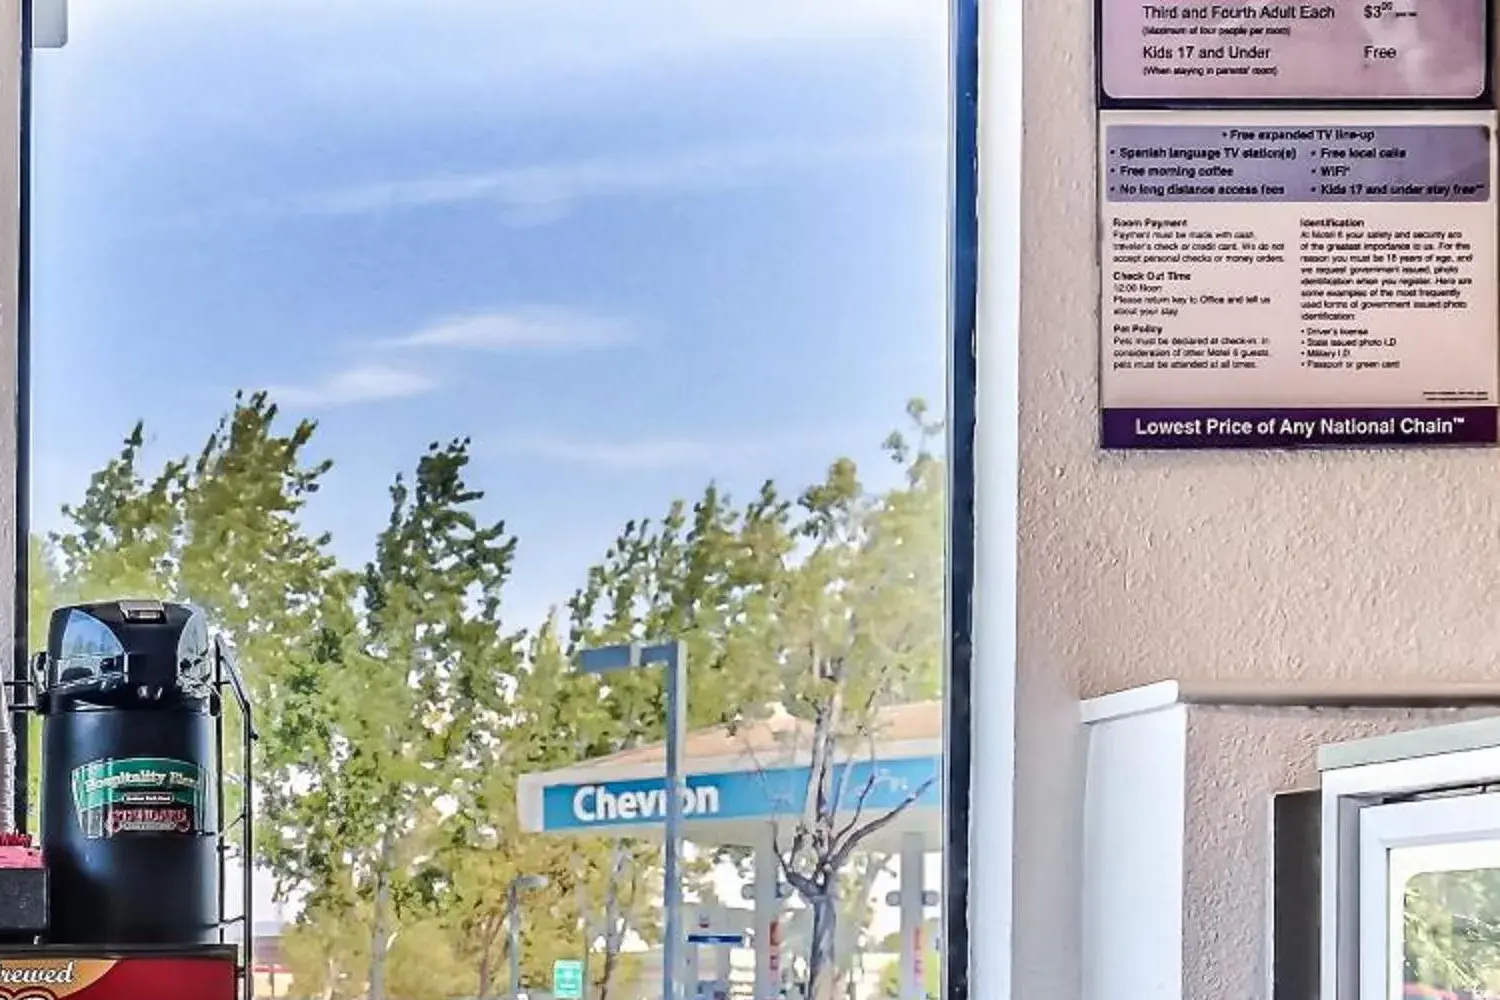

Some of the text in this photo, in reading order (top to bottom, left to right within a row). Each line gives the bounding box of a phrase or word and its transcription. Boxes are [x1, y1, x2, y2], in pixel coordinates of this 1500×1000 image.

[1142, 6, 1335, 19] Third and Fourth Adult Each
[1143, 46, 1270, 58] Kids 17 and Under
[1364, 46, 1396, 58] Free
[1230, 130, 1255, 140] Free
[1258, 130, 1314, 142] expanded
[1316, 129, 1332, 140] TV
[1120, 148, 1166, 160] Spanish
[1169, 148, 1221, 160] language
[1224, 148, 1240, 158] TV
[1321, 148, 1346, 158] Free
[1349, 148, 1376, 158] local
[1120, 166, 1233, 178] Free morning coffee
[1120, 184, 1136, 194] No
[1139, 184, 1164, 196] long
[1167, 184, 1215, 194] distance
[1218, 186, 1258, 194] access
[1321, 184, 1346, 194] Kids
[1350, 184, 1362, 194] 17
[1366, 185, 1388, 194] and
[1390, 184, 1424, 194] under
[1427, 186, 1450, 197] stay
[1136, 419, 1201, 434] Lowest
[1207, 418, 1252, 434] Price
[1257, 418, 1275, 434] of
[1280, 419, 1315, 438] Any
[1321, 418, 1394, 434] National
